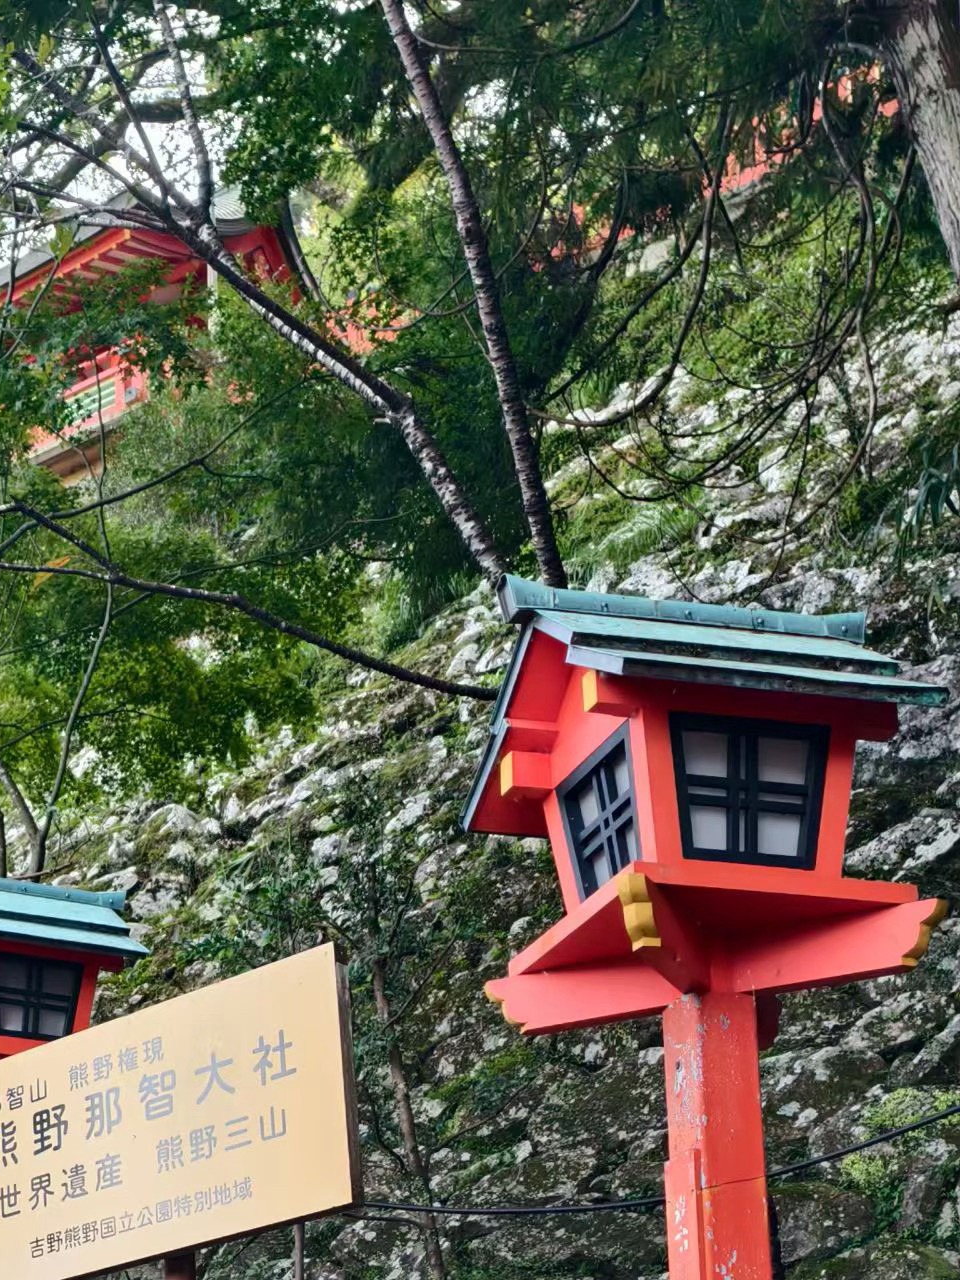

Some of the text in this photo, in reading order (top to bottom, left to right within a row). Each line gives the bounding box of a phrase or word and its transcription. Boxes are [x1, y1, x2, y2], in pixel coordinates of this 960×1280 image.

[68, 1036, 165, 1091] 熊野権現
[156, 1106, 287, 1174] 熊野三山
[29, 1176, 252, 1259] 吉野熊野国立公園特別地域
